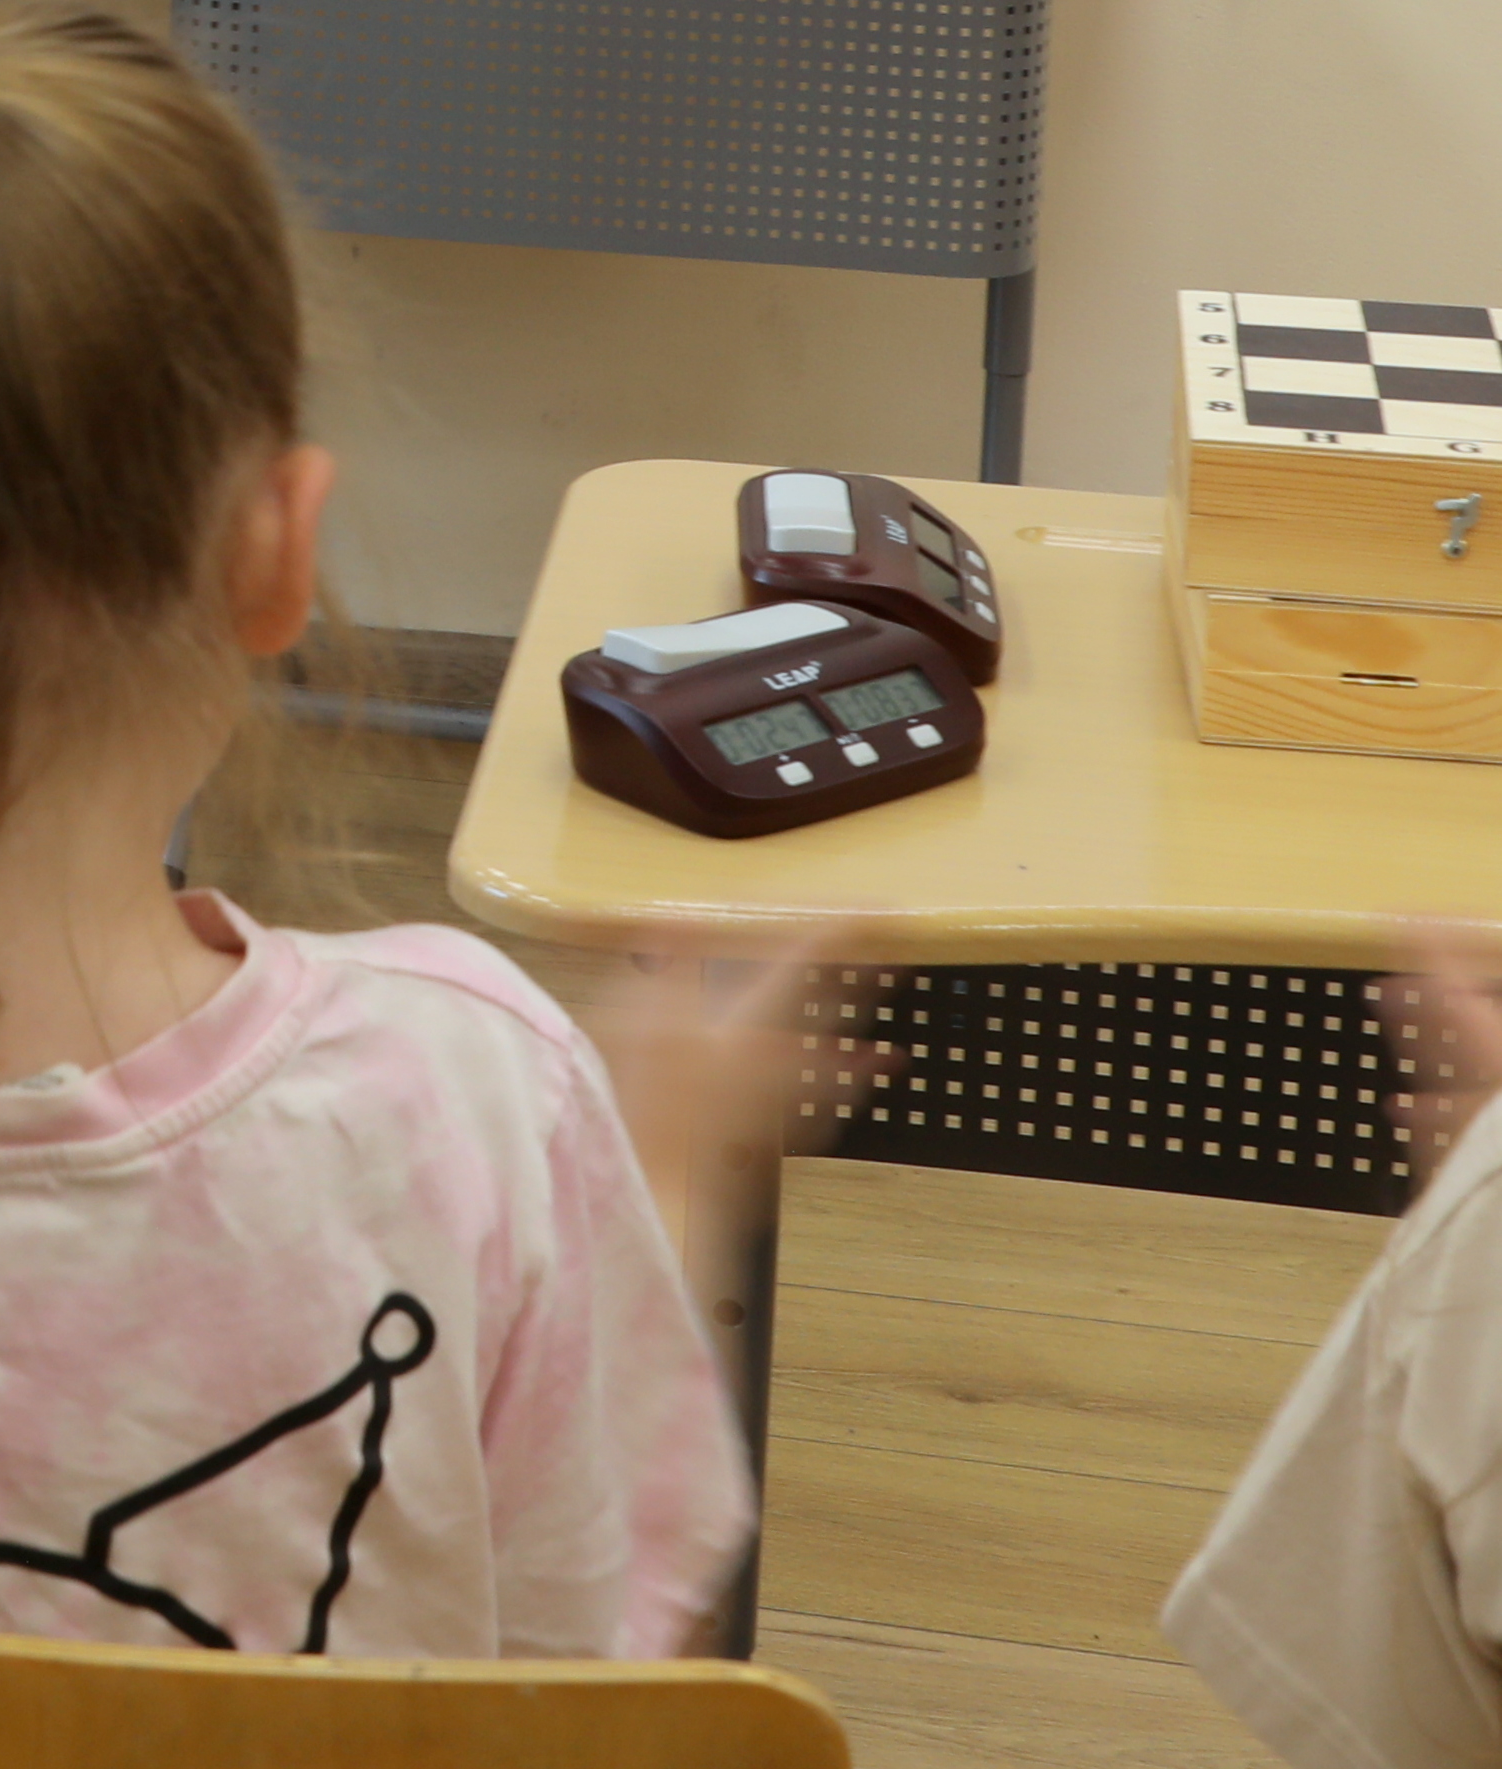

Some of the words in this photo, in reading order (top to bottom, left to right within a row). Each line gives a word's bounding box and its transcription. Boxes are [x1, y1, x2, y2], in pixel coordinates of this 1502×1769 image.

[1197, 302, 1225, 313] 5
[1199, 334, 1229, 344] 6
[1207, 366, 1233, 377] 7
[1206, 400, 1236, 413] 8
[1302, 432, 1341, 445] H
[1447, 442, 1482, 454] G
[761, 665, 820, 690] LEAP
